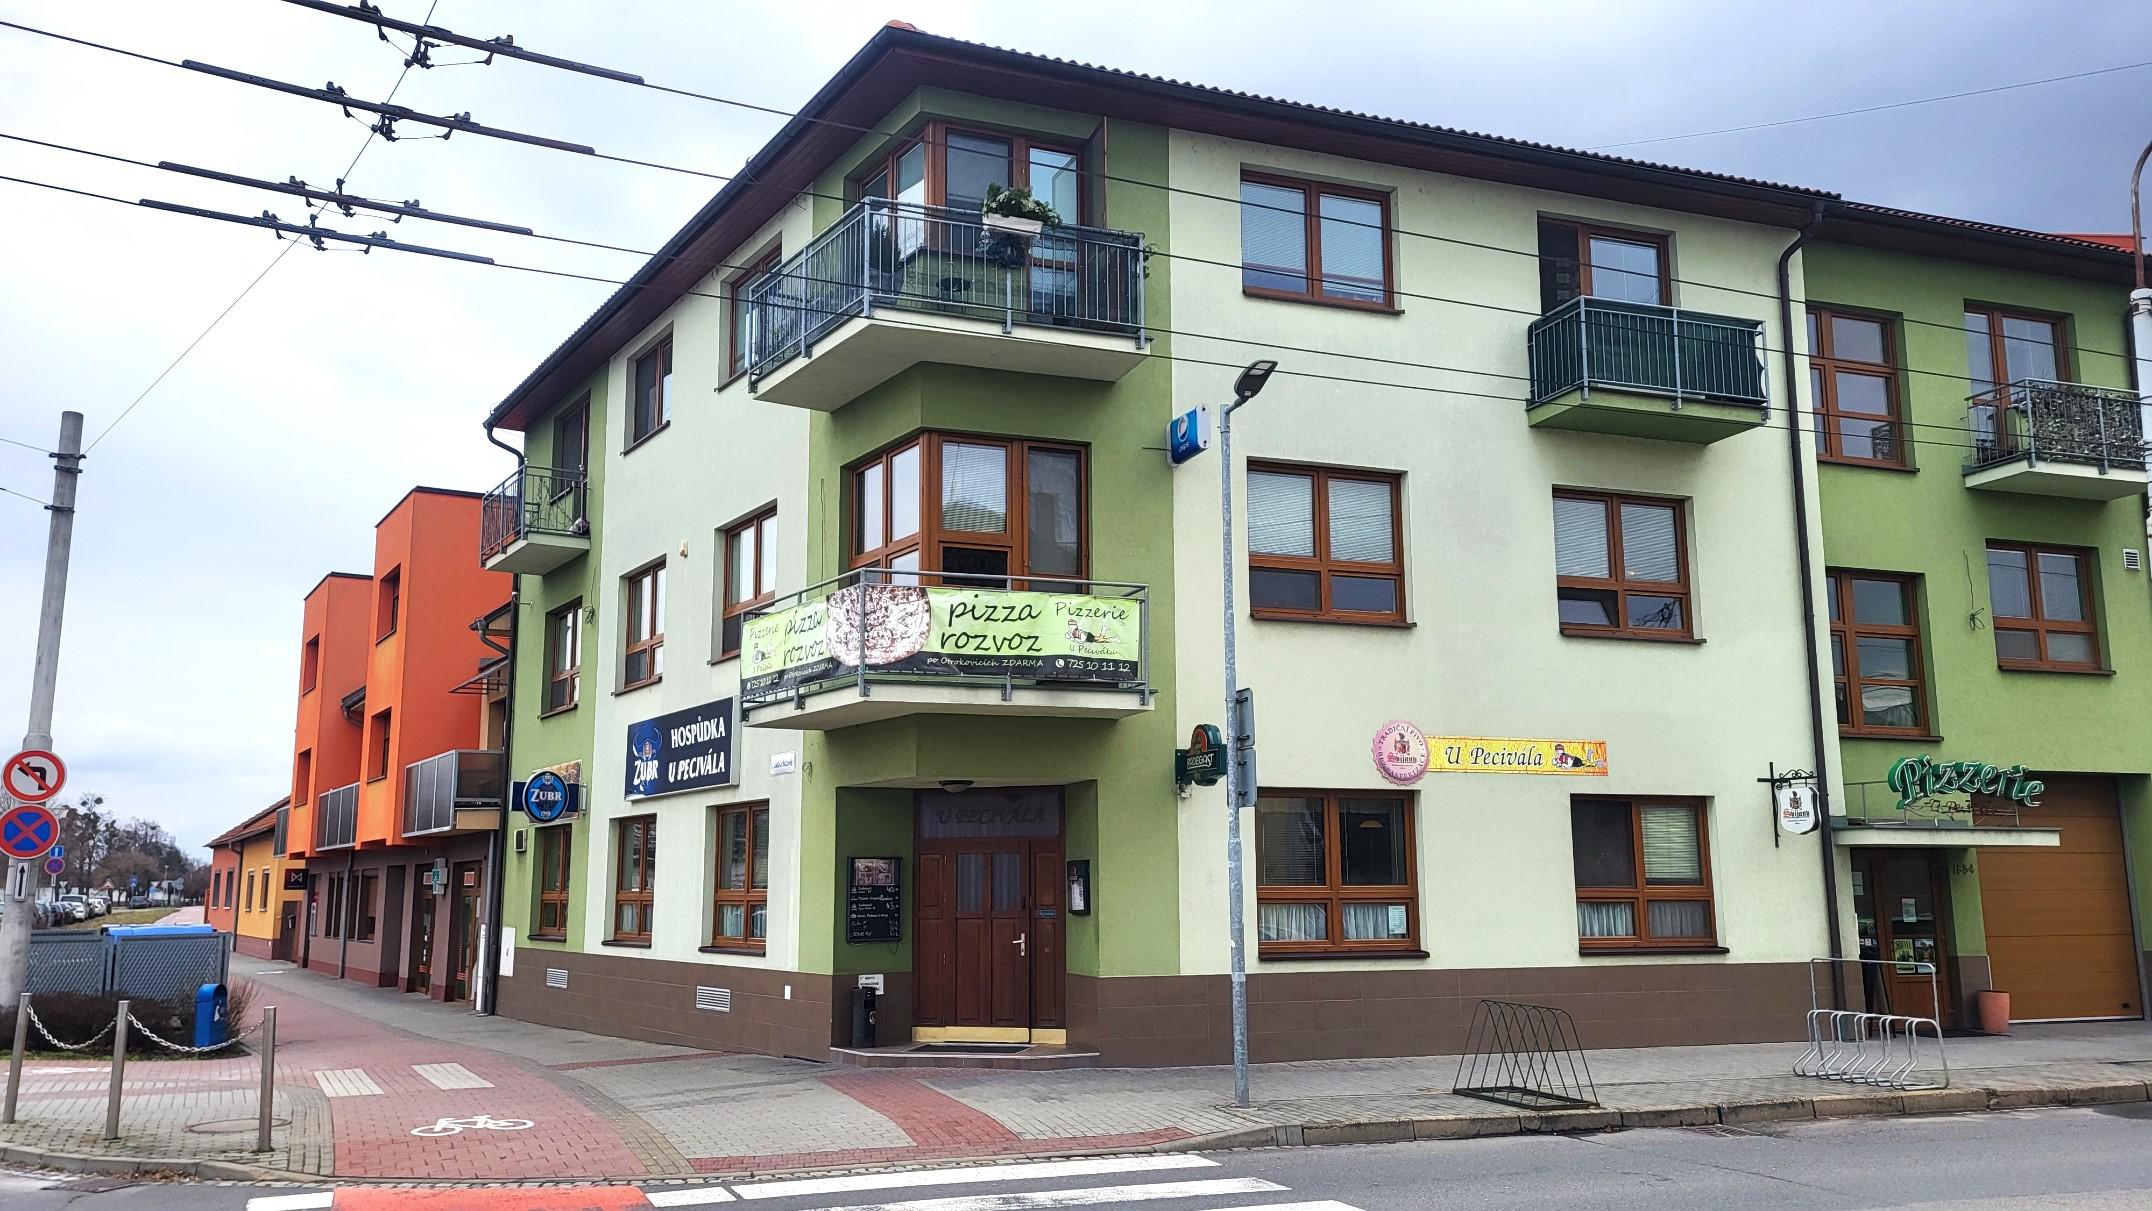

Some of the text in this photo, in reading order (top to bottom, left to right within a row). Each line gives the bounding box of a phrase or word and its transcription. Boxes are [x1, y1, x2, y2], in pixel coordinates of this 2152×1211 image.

[948, 593, 1042, 628] pizza
[1055, 601, 1130, 620] Pizzerie
[783, 609, 823, 644] pizza
[783, 639, 825, 666] rozvoz
[940, 631, 1043, 653] rozvoz
[927, 657, 938, 665] po
[1001, 659, 1044, 667] ZDARMA
[1067, 658, 1131, 672] 725 10 11 12
[670, 715, 726, 749] HOSPŮDKA
[1378, 724, 1424, 746] TRADIČNÍ PIVO
[668, 748, 726, 783] U PECIVÁLA
[1445, 745, 1544, 767] U Pecivála
[632, 759, 659, 786] ZUBR
[1888, 753, 2045, 810] Pizzerie
[530, 788, 562, 802] ZUBR
